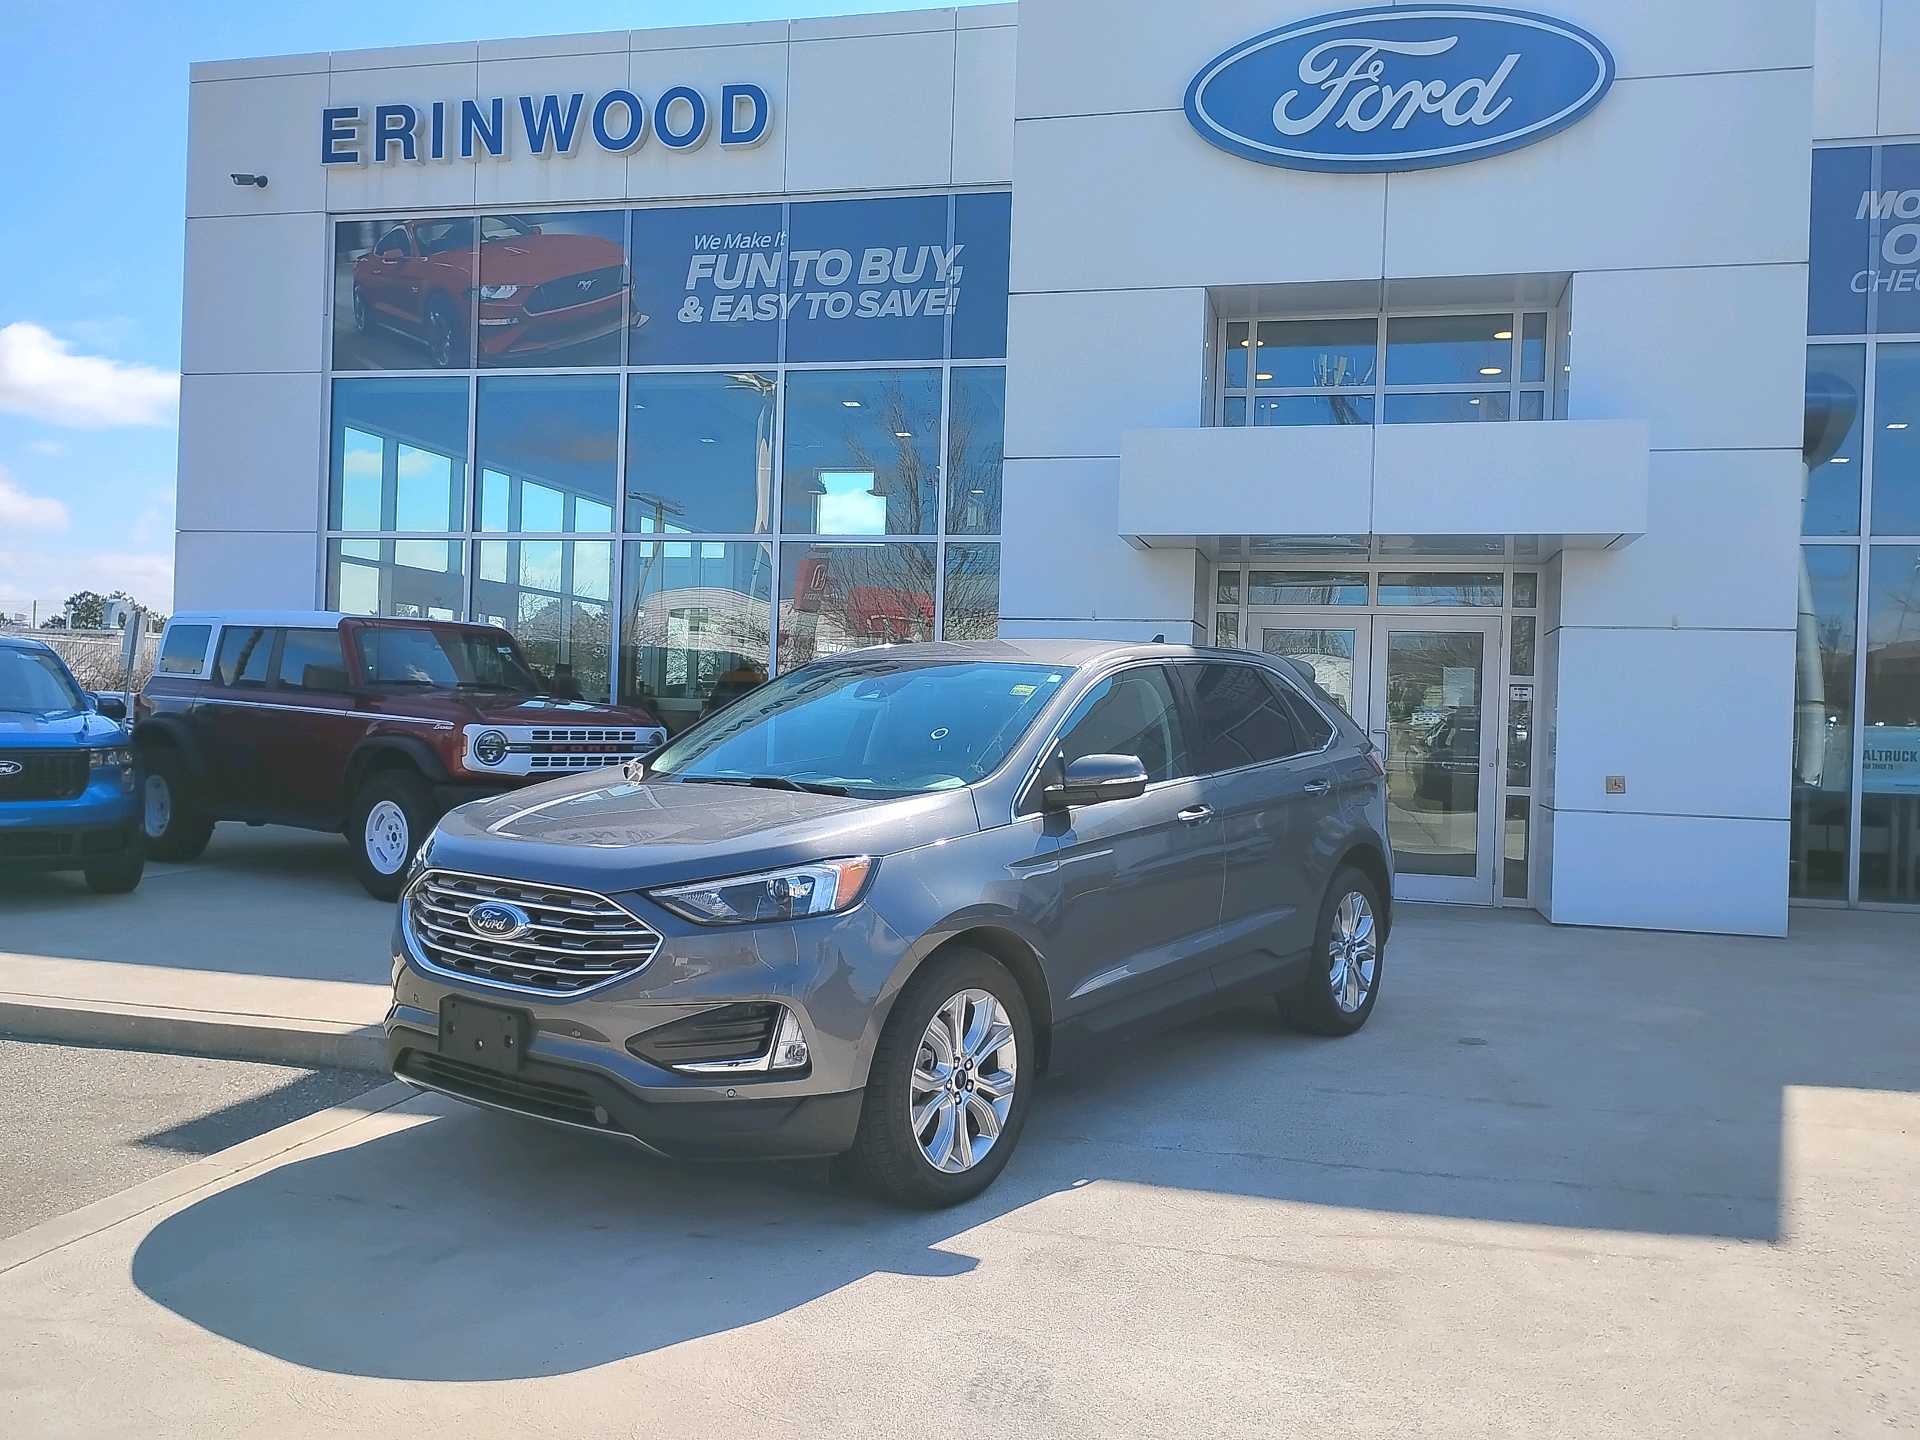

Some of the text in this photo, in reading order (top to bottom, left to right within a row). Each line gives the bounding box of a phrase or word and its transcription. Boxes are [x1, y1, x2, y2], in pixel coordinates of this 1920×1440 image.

[1272, 36, 1521, 136] Ford
[320, 82, 771, 168] ERINWOOD
[693, 230, 787, 250] We Make It
[685, 244, 965, 290] FUN TO BUY,
[677, 287, 960, 323] & EASY TO SAVE!
[477, 909, 507, 931] Ford
